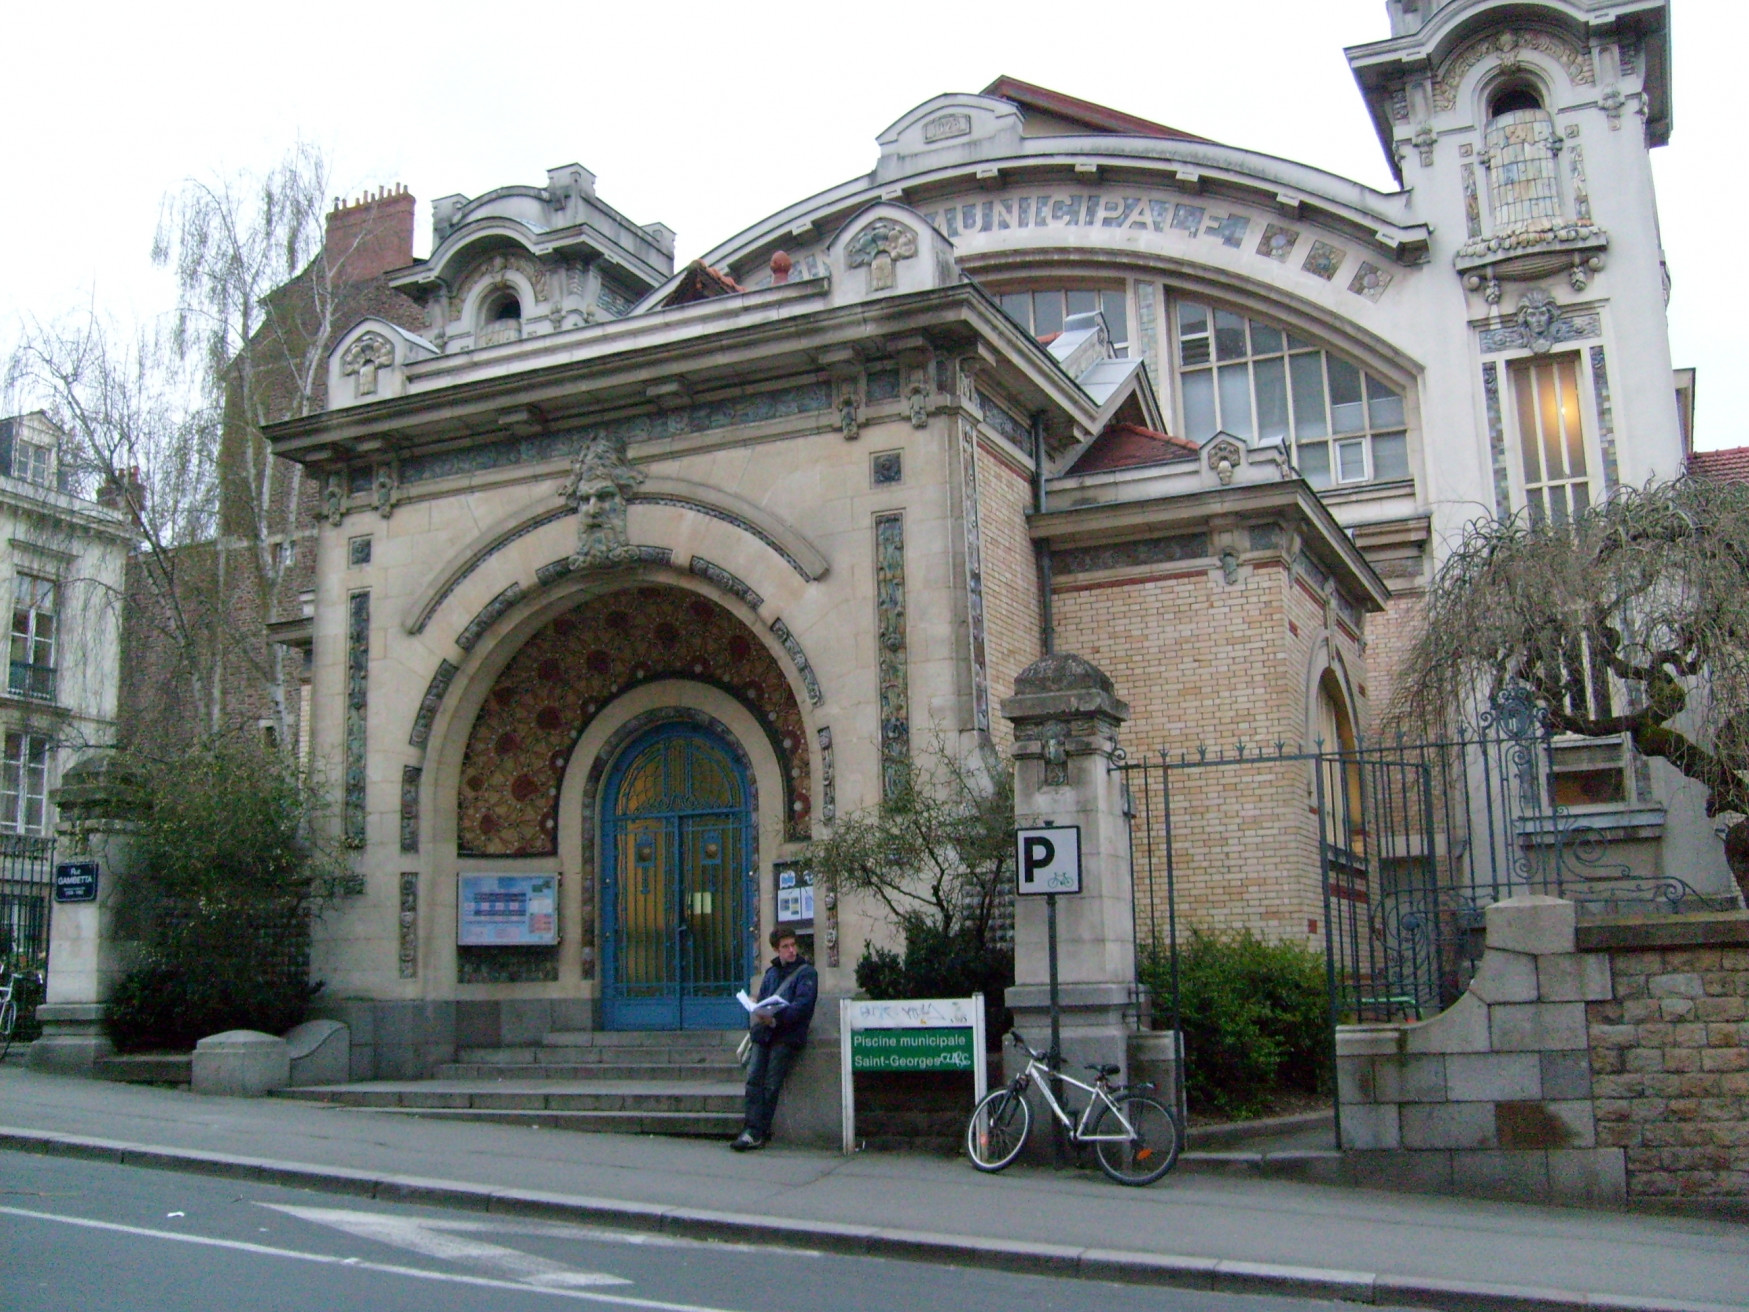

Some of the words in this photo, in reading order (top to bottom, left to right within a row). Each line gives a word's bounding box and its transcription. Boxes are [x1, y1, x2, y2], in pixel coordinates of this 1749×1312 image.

[1024, 837, 1055, 883] P
[58, 875, 92, 885] GAMBETTA
[854, 1035, 897, 1047] Piscine
[900, 1034, 966, 1049] municipale
[854, 1053, 942, 1069] Saint-Georges
